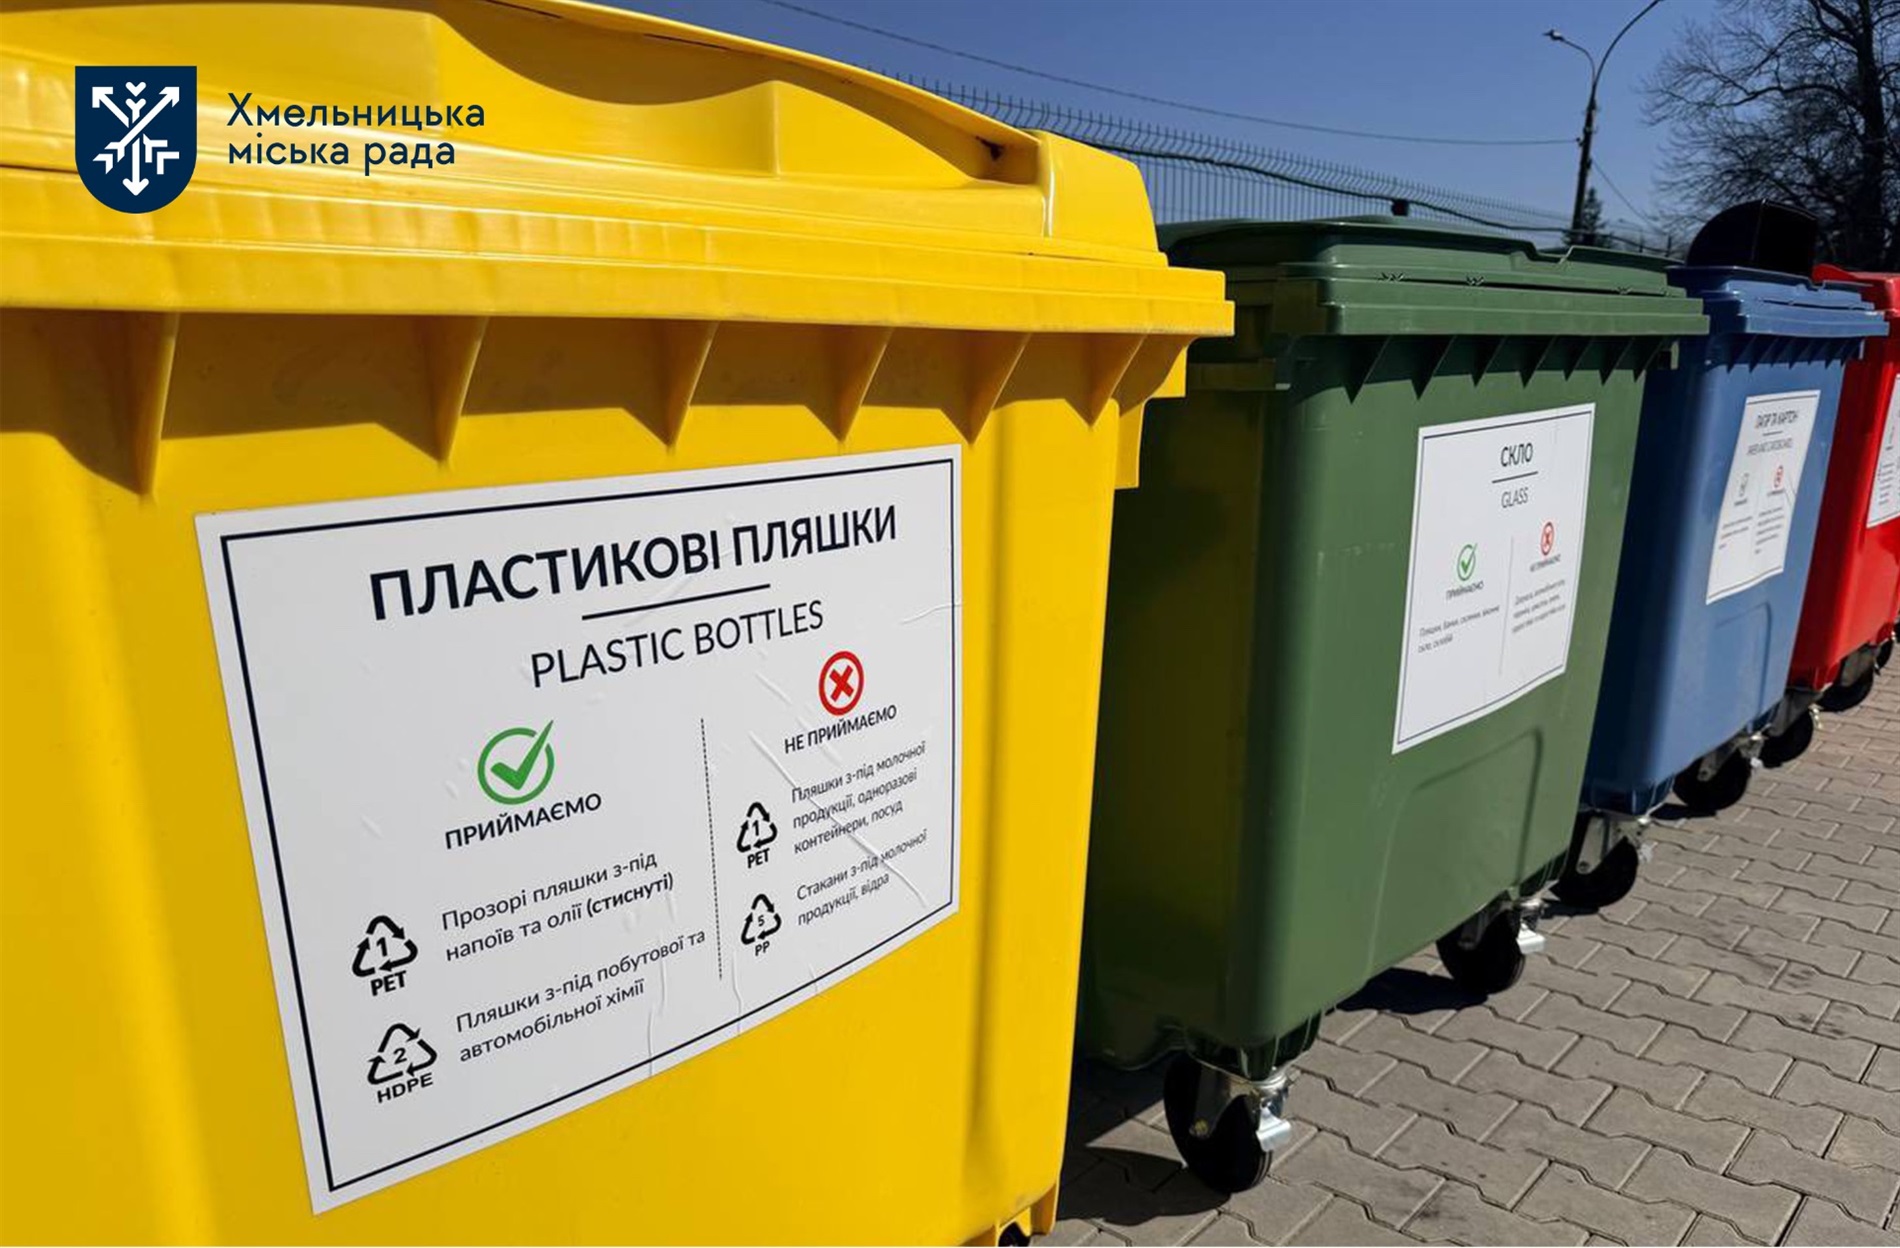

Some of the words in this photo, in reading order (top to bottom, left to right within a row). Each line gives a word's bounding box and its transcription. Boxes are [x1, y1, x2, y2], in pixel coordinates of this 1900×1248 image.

[1500, 442, 1534, 467] СКЛО
[1501, 486, 1529, 508] GLASS
[369, 529, 720, 621] ПЛАСТИКОВІ
[732, 504, 898, 567] ПЛЯШКИ
[530, 627, 686, 689] PLASTIC
[693, 599, 825, 656] BOTTLES
[784, 734, 805, 754] НЕ
[808, 704, 897, 746] ПРИЙМАЄМО
[791, 775, 843, 803] Пляшки
[846, 763, 875, 787] з-під
[876, 741, 926, 772] молочної
[793, 794, 856, 829] продукції,
[858, 767, 918, 806] одноразові
[443, 792, 603, 851] ПРИЙМАЄМО
[752, 819, 760, 837] 1
[794, 816, 869, 854] контейнери,
[871, 800, 903, 826] посуд
[747, 849, 770, 869] PET
[796, 871, 848, 901] Стакани
[851, 855, 879, 879] з-під
[441, 889, 528, 932] Прозорі
[532, 869, 609, 903] пляшки
[612, 852, 658, 879] з-під
[445, 927, 515, 962] напоїв
[519, 919, 542, 938] та
[546, 903, 583, 930] олії
[586, 871, 674, 918] (стиснуті)
[798, 887, 859, 926] продукції,
[860, 873, 890, 898] відра
[376, 936, 389, 958] 1
[370, 970, 408, 997] PET
[455, 993, 541, 1033] Пляшки
[544, 972, 593, 1002] з-під
[597, 940, 685, 984] побутової
[686, 929, 706, 946] та
[459, 996, 605, 1063] автомобільної
[606, 978, 645, 1008] хімії
[393, 1047, 407, 1065] 2
[376, 1072, 434, 1104] HDPE
